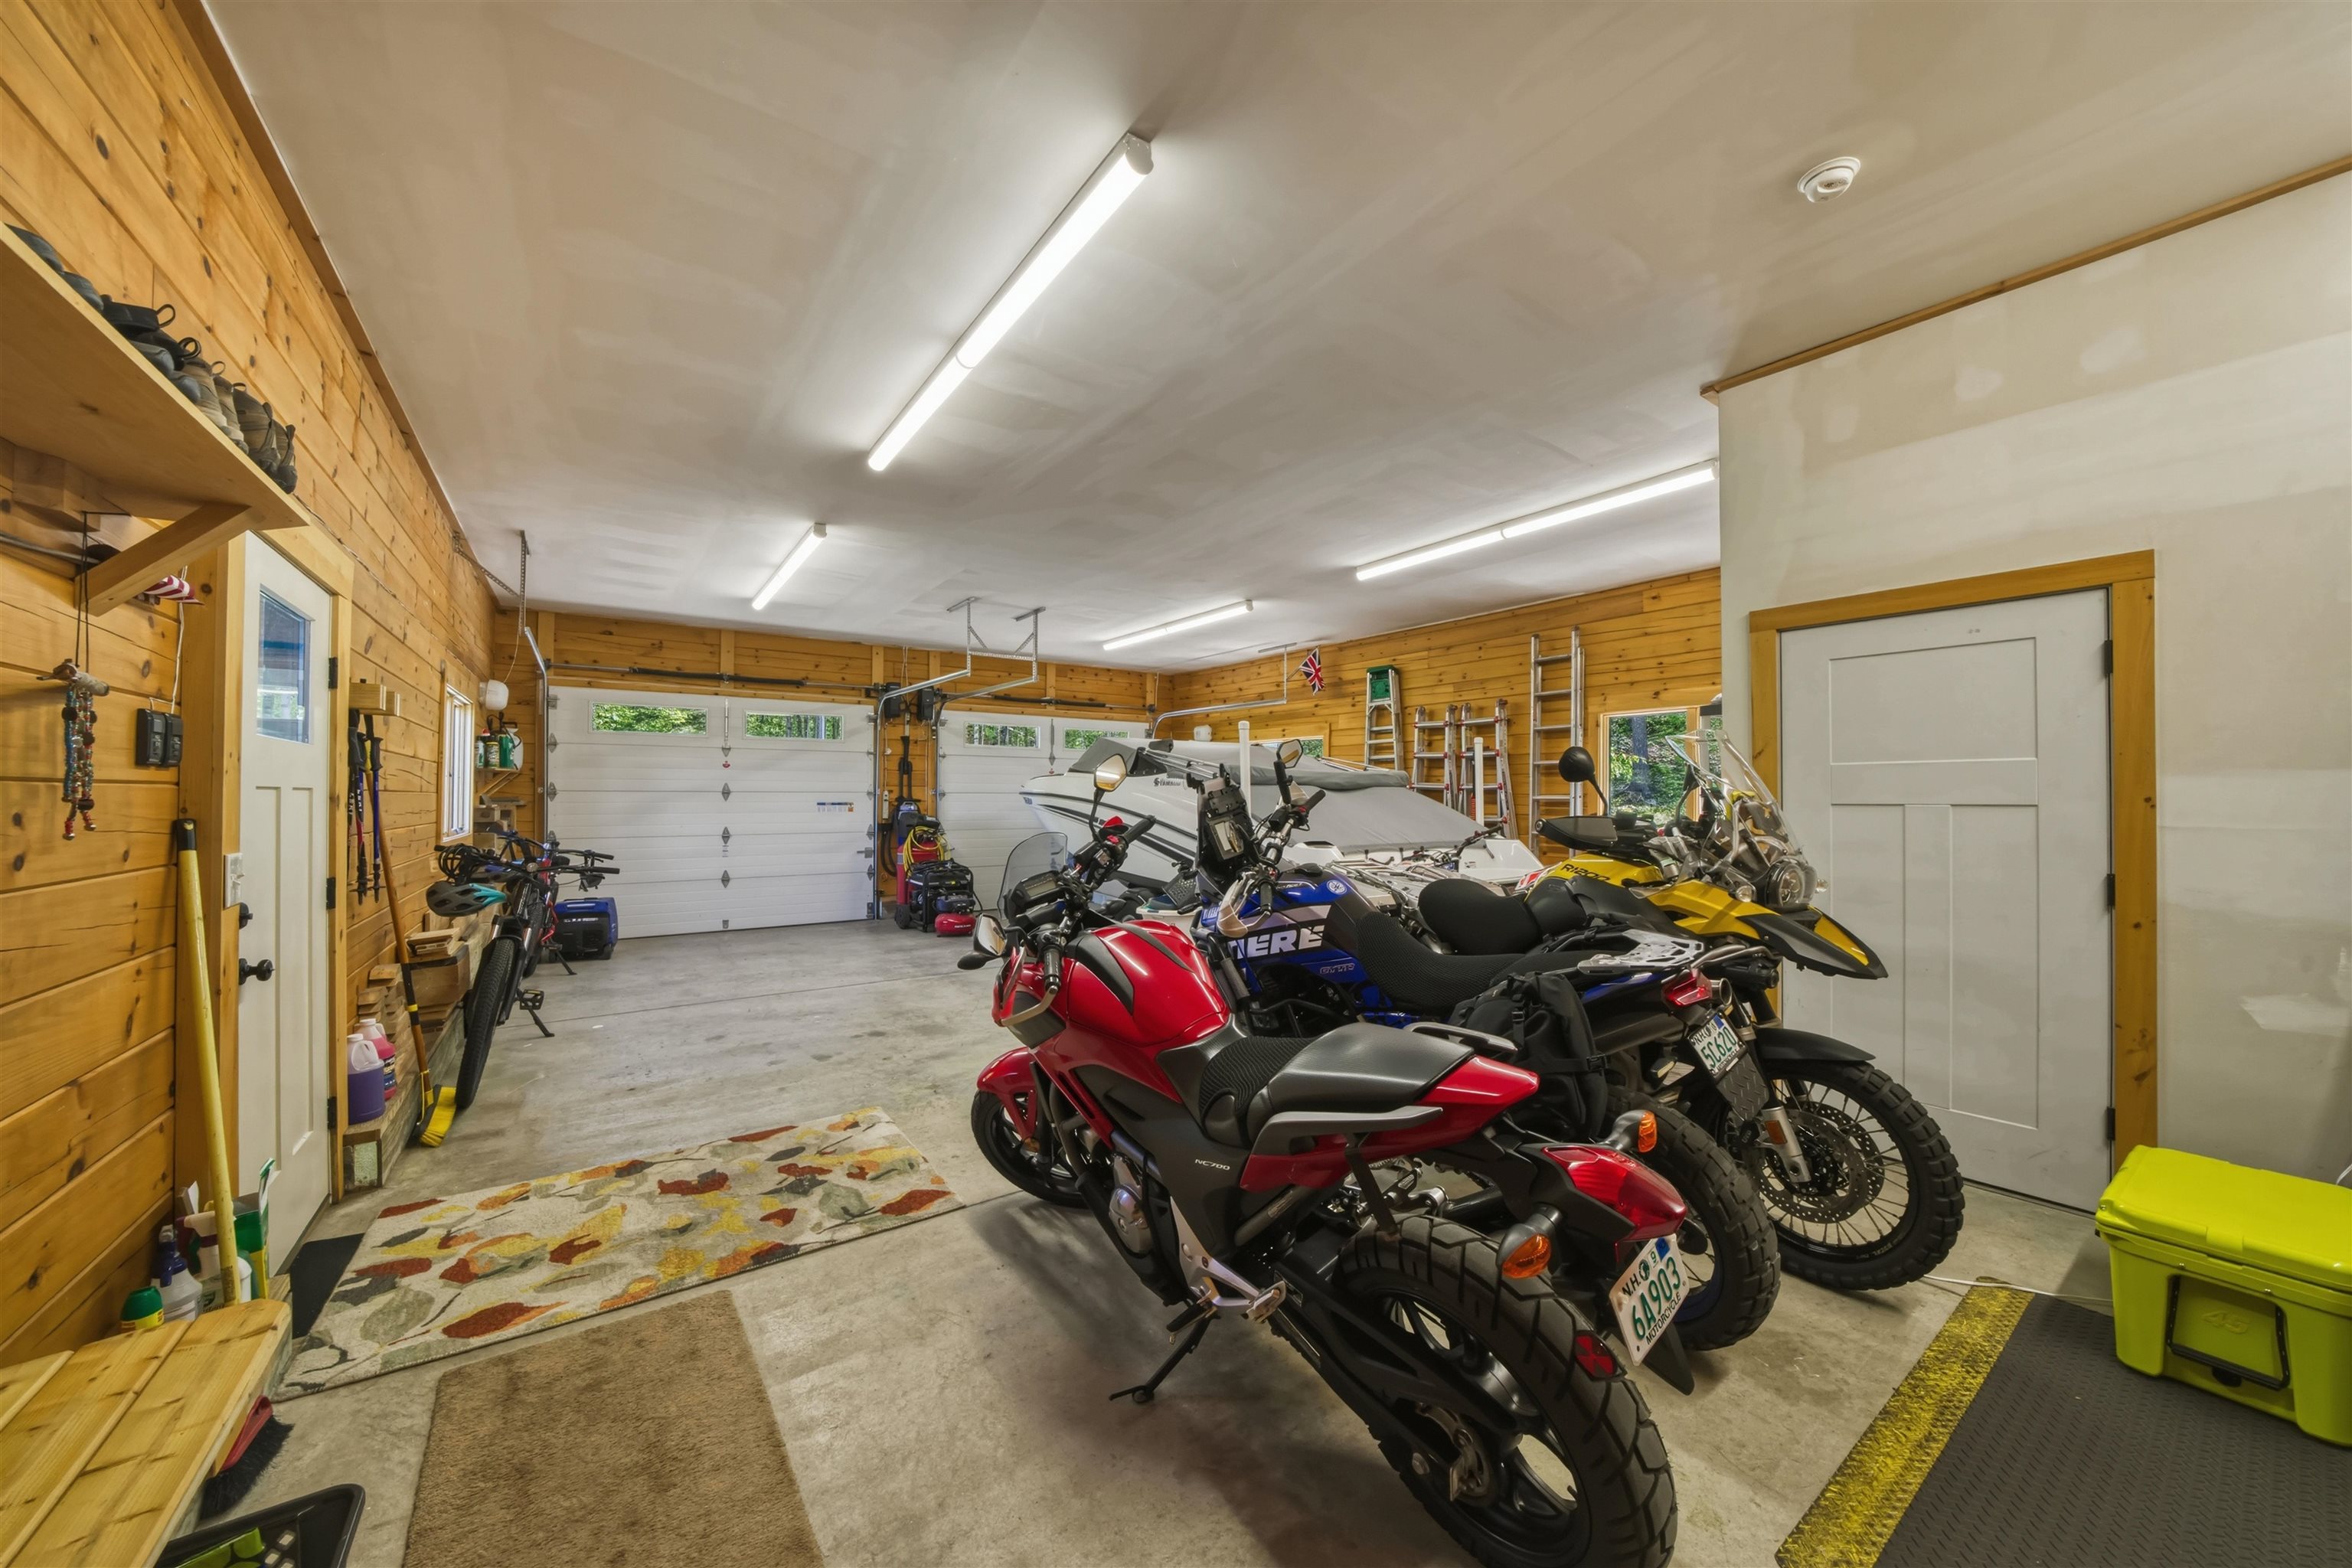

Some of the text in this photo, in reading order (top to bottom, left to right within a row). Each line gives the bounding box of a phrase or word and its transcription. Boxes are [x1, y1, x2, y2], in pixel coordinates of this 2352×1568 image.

[1560, 864, 1611, 881] R1200
[1700, 1026, 1737, 1068] 5C620
[1194, 1158, 1230, 1171] NC700
[1632, 1256, 1681, 1341] 6A903
[1645, 1292, 1681, 1345] MOTORCYCLE
